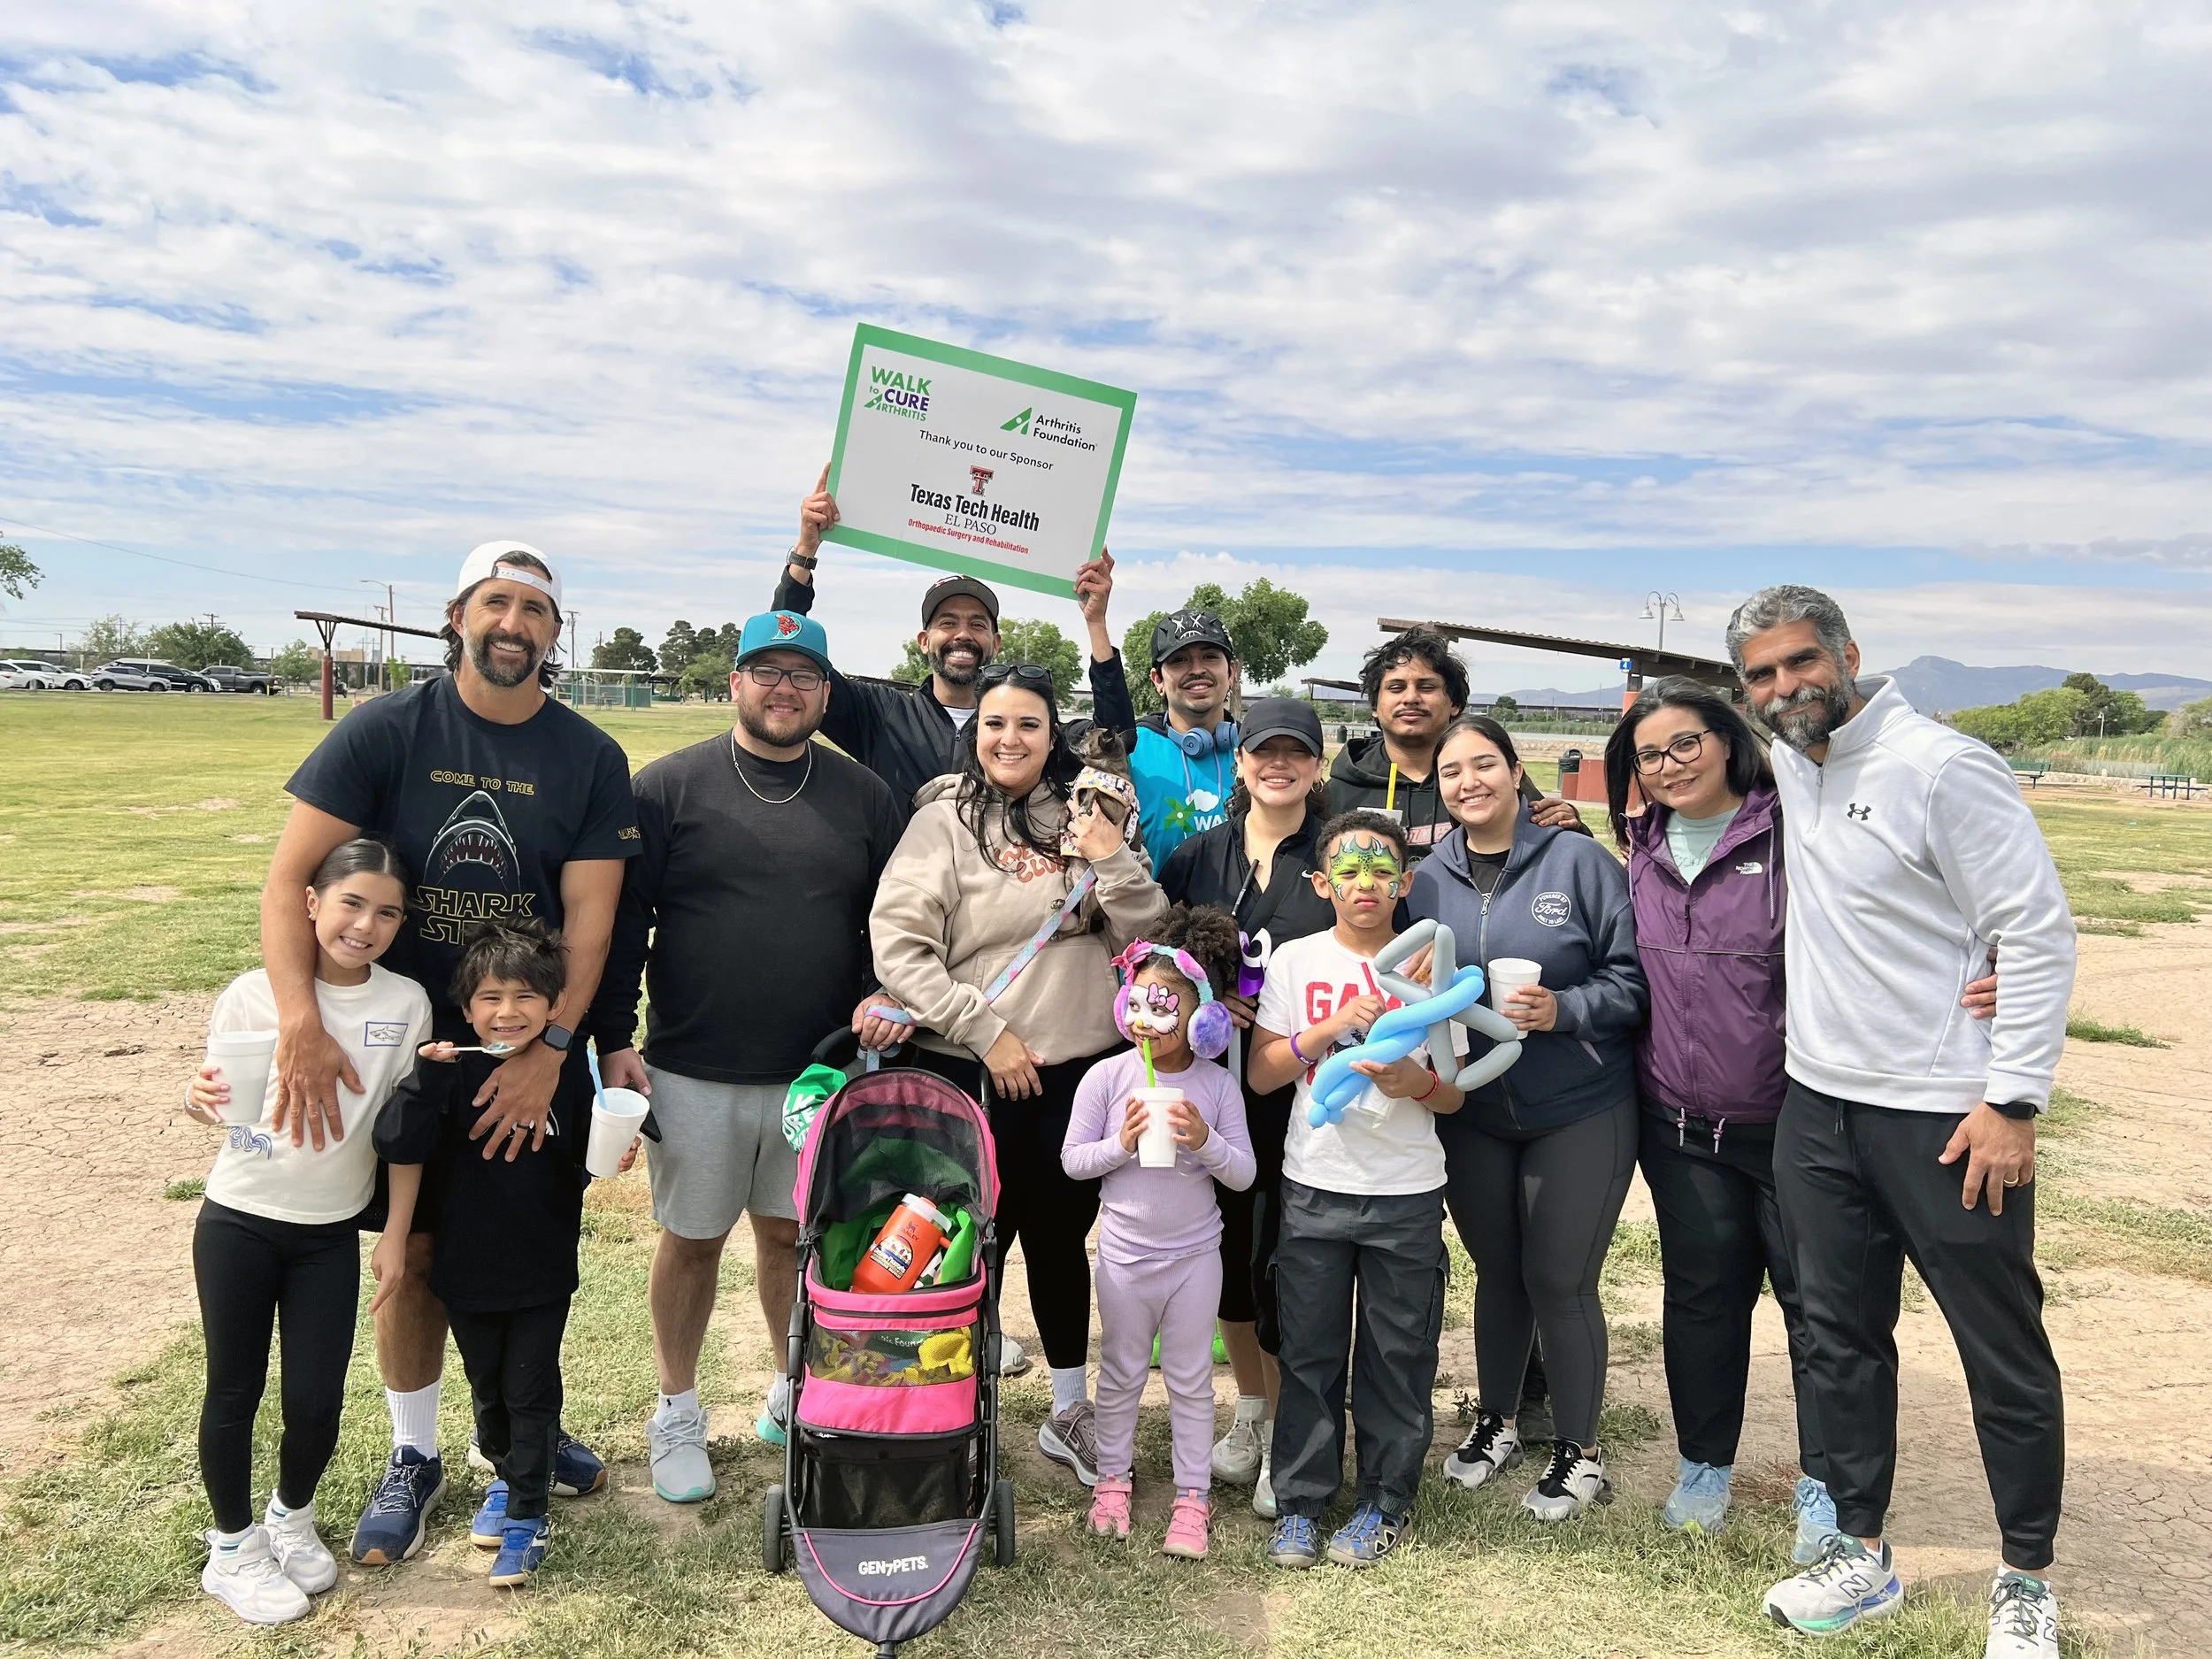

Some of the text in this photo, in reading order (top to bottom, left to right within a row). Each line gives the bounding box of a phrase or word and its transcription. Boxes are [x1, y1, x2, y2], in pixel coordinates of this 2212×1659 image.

[872, 365, 933, 396] WALK
[864, 394, 926, 421] ARTHRITIS
[869, 385, 930, 411] to CURE
[1036, 415, 1081, 434] Arthritis
[919, 429, 1054, 471] Thank you to our Sponsor
[1033, 427, 1096, 451] Foundation
[910, 483, 1040, 532] Texas Tech Health
[908, 518, 1029, 555] Orthopaedic Surgery and Rehabilitation
[944, 513, 997, 535] EL PASO
[430, 770, 534, 795] COME TO THE
[416, 885, 536, 919] SHARK
[1534, 902, 1568, 916] Ford
